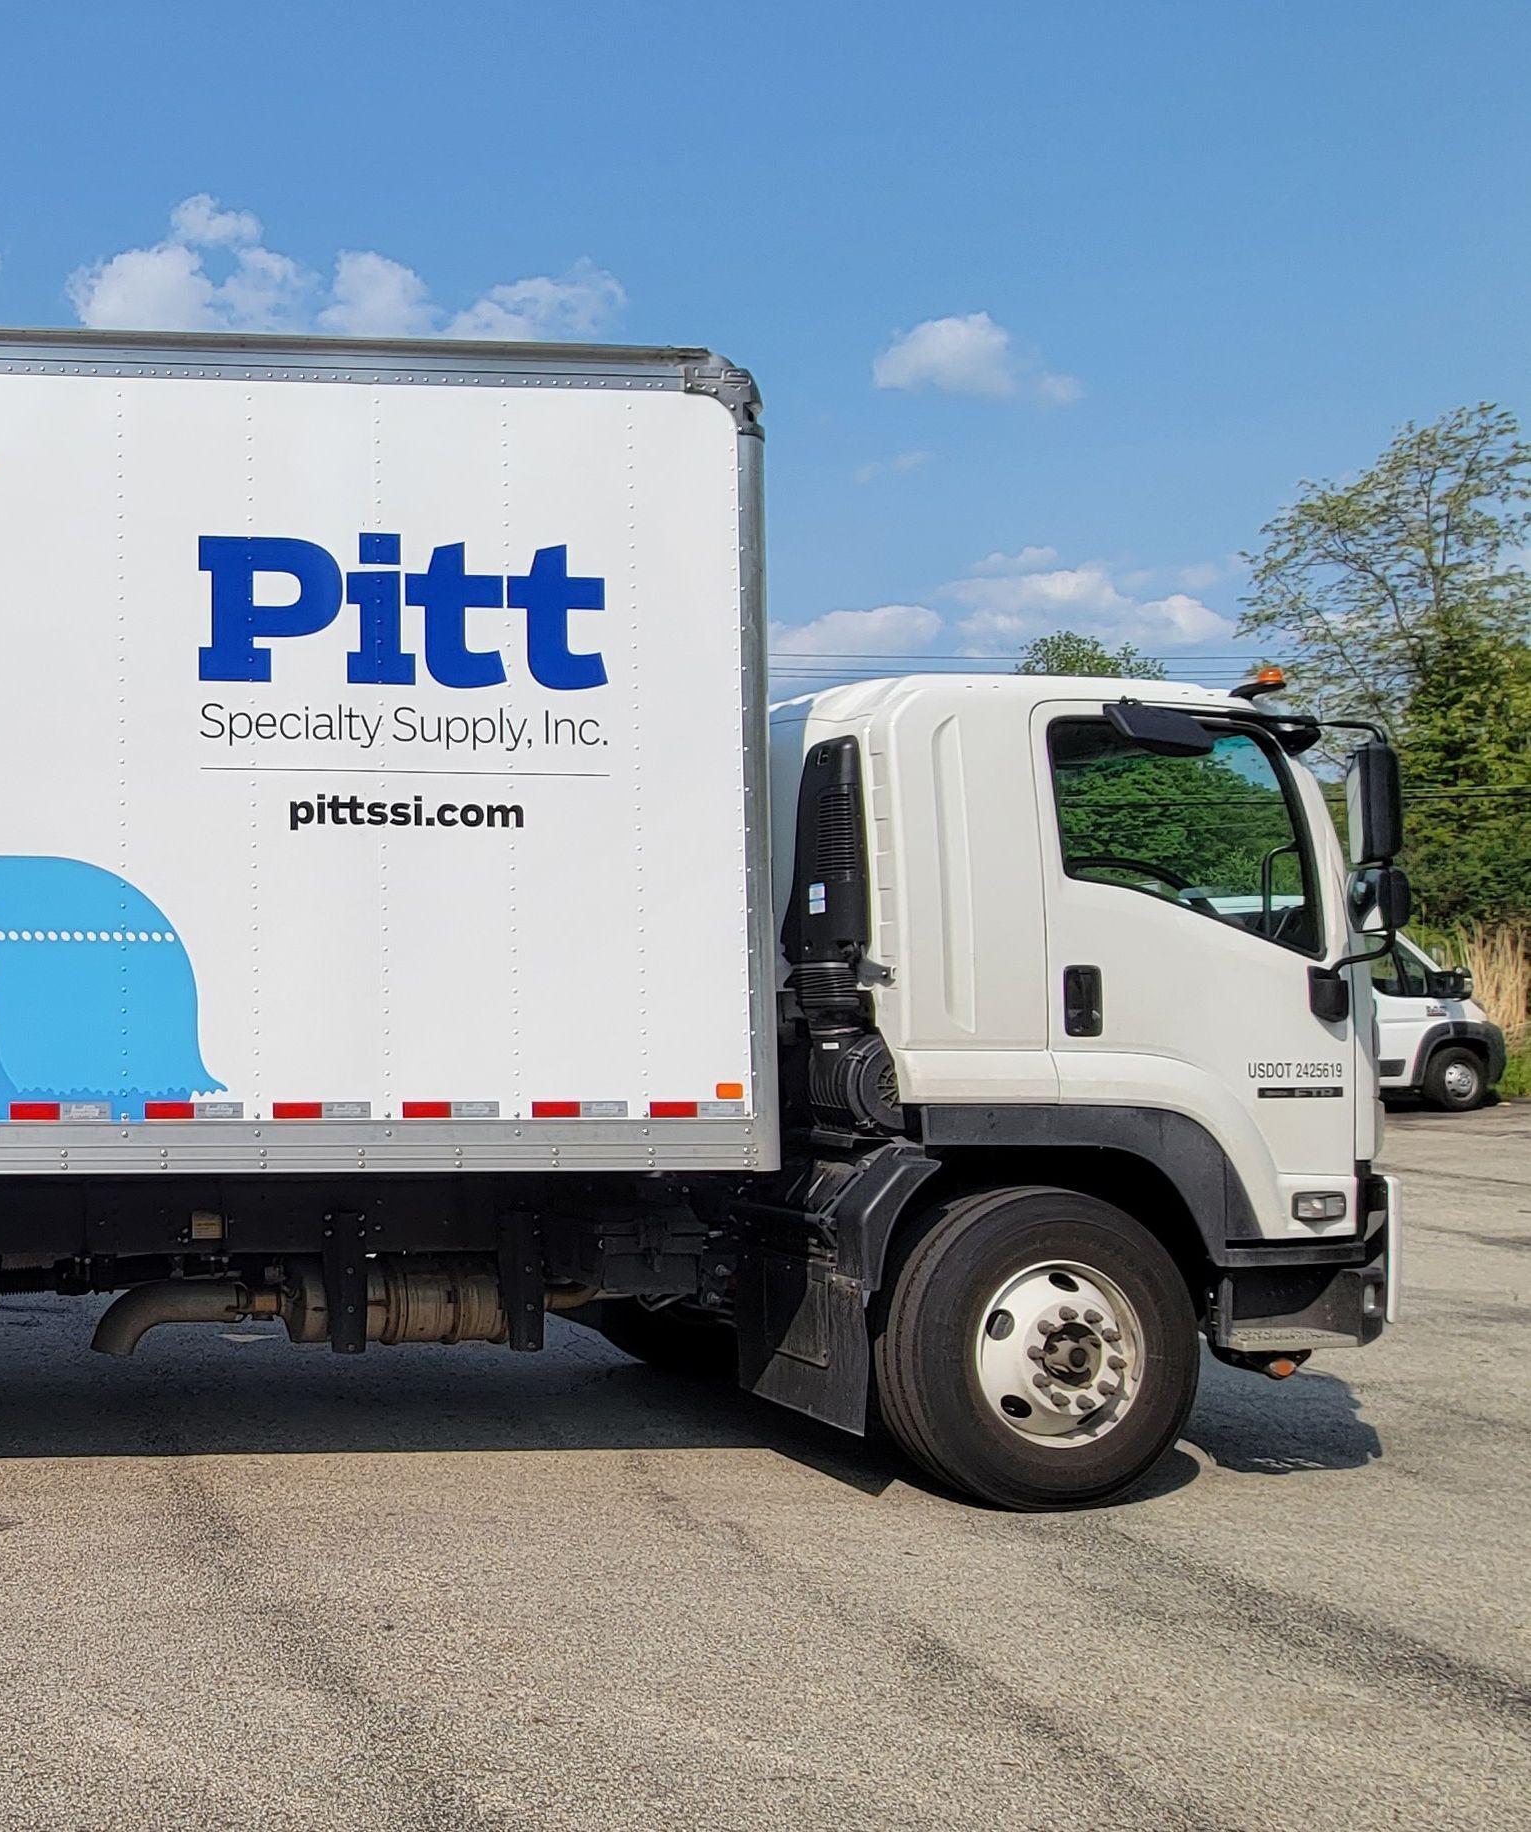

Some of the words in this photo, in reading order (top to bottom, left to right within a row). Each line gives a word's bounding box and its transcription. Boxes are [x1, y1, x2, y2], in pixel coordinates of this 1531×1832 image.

[198, 532, 609, 691] Pitt
[199, 703, 383, 749] Specialty
[392, 706, 533, 752] Supply,
[544, 710, 609, 746] Inc.
[289, 793, 525, 831] pittssi.com
[1248, 1062, 1292, 1079] USDOT
[1296, 1062, 1343, 1079] 2425619
